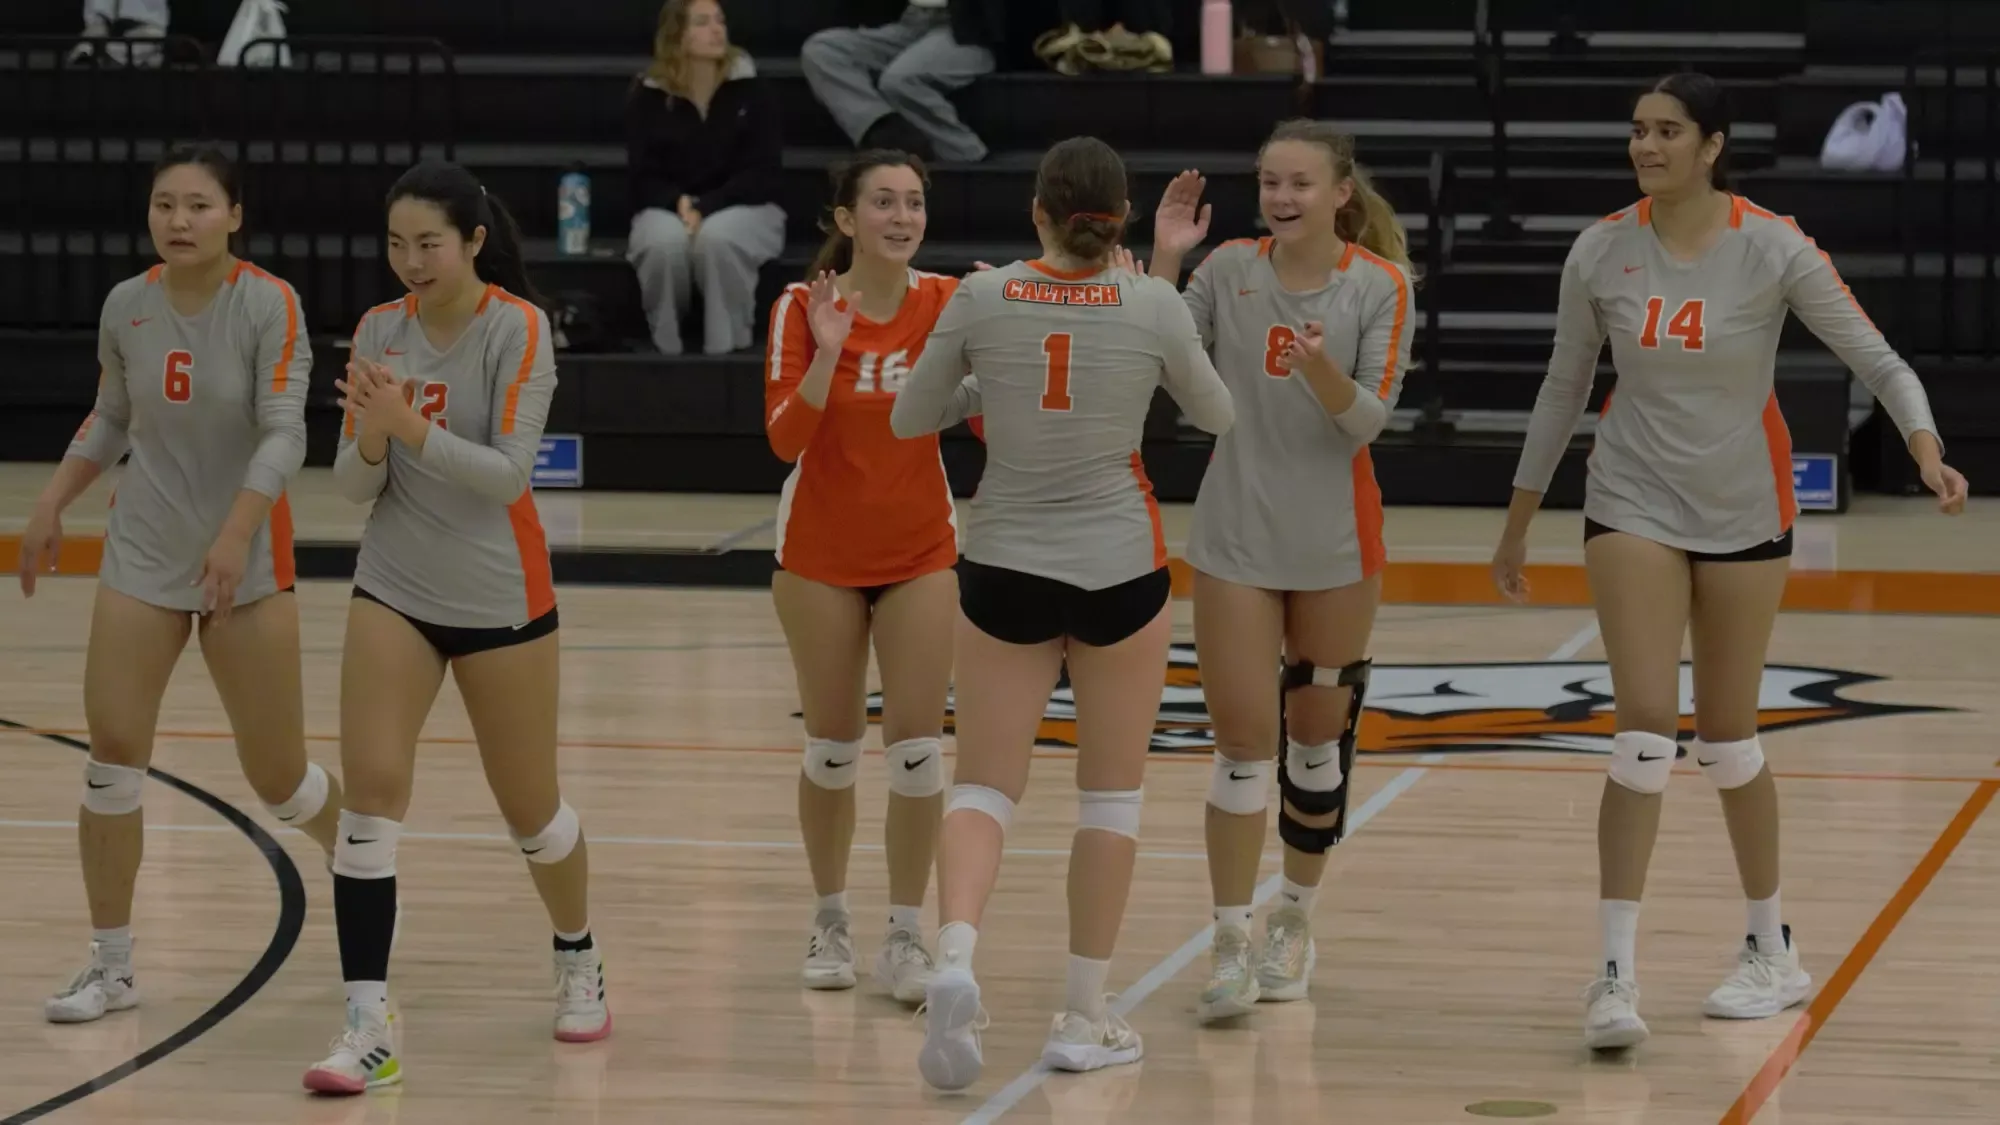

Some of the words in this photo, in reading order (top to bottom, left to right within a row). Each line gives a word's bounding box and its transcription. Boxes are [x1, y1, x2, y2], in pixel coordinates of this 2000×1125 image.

[1003, 279, 1121, 306] CALTECH
[1639, 295, 1705, 352] 14
[164, 350, 193, 403] 6
[855, 349, 910, 393] 16
[1040, 332, 1073, 412] 1
[1264, 324, 1297, 379] 8
[402, 379, 449, 432] 2
